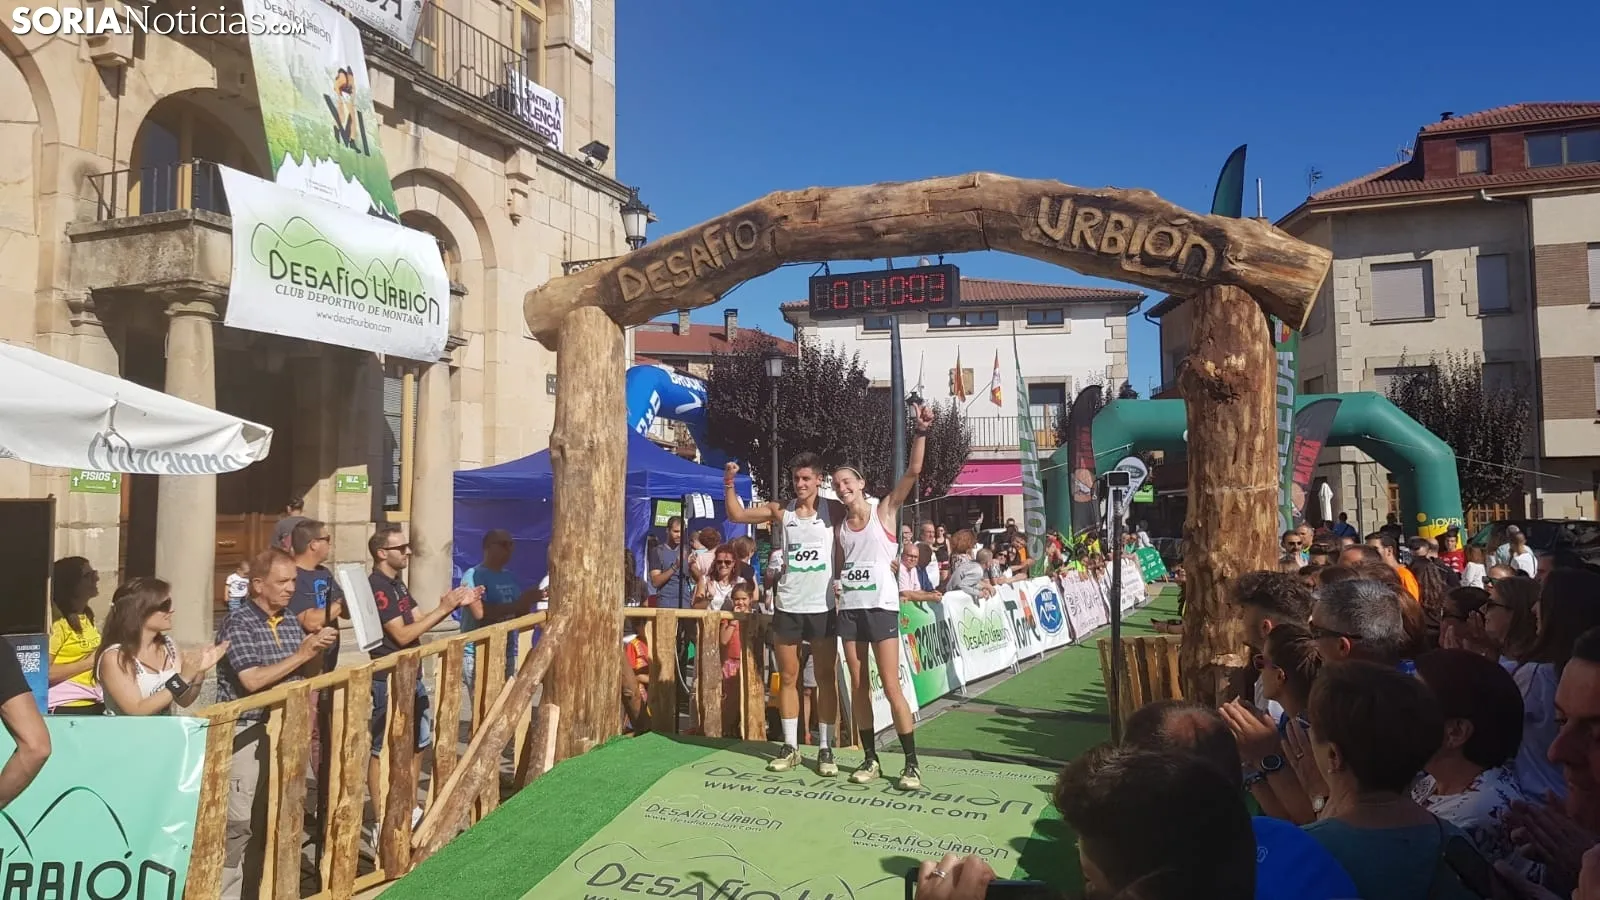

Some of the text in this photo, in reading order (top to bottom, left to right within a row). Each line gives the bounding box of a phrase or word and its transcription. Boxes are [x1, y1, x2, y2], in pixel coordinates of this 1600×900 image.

[275, 284, 424, 326] CLUB DEPORTIVO DE MONTAÑA
[316, 310, 392, 333] www.desafiourbion.com
[80, 470, 112, 481] FISIOS
[795, 550, 819, 562] 692
[847, 569, 870, 581] 684
[704, 780, 988, 822] www.desafiourbion.com
[0, 848, 176, 900] RBIÓN
